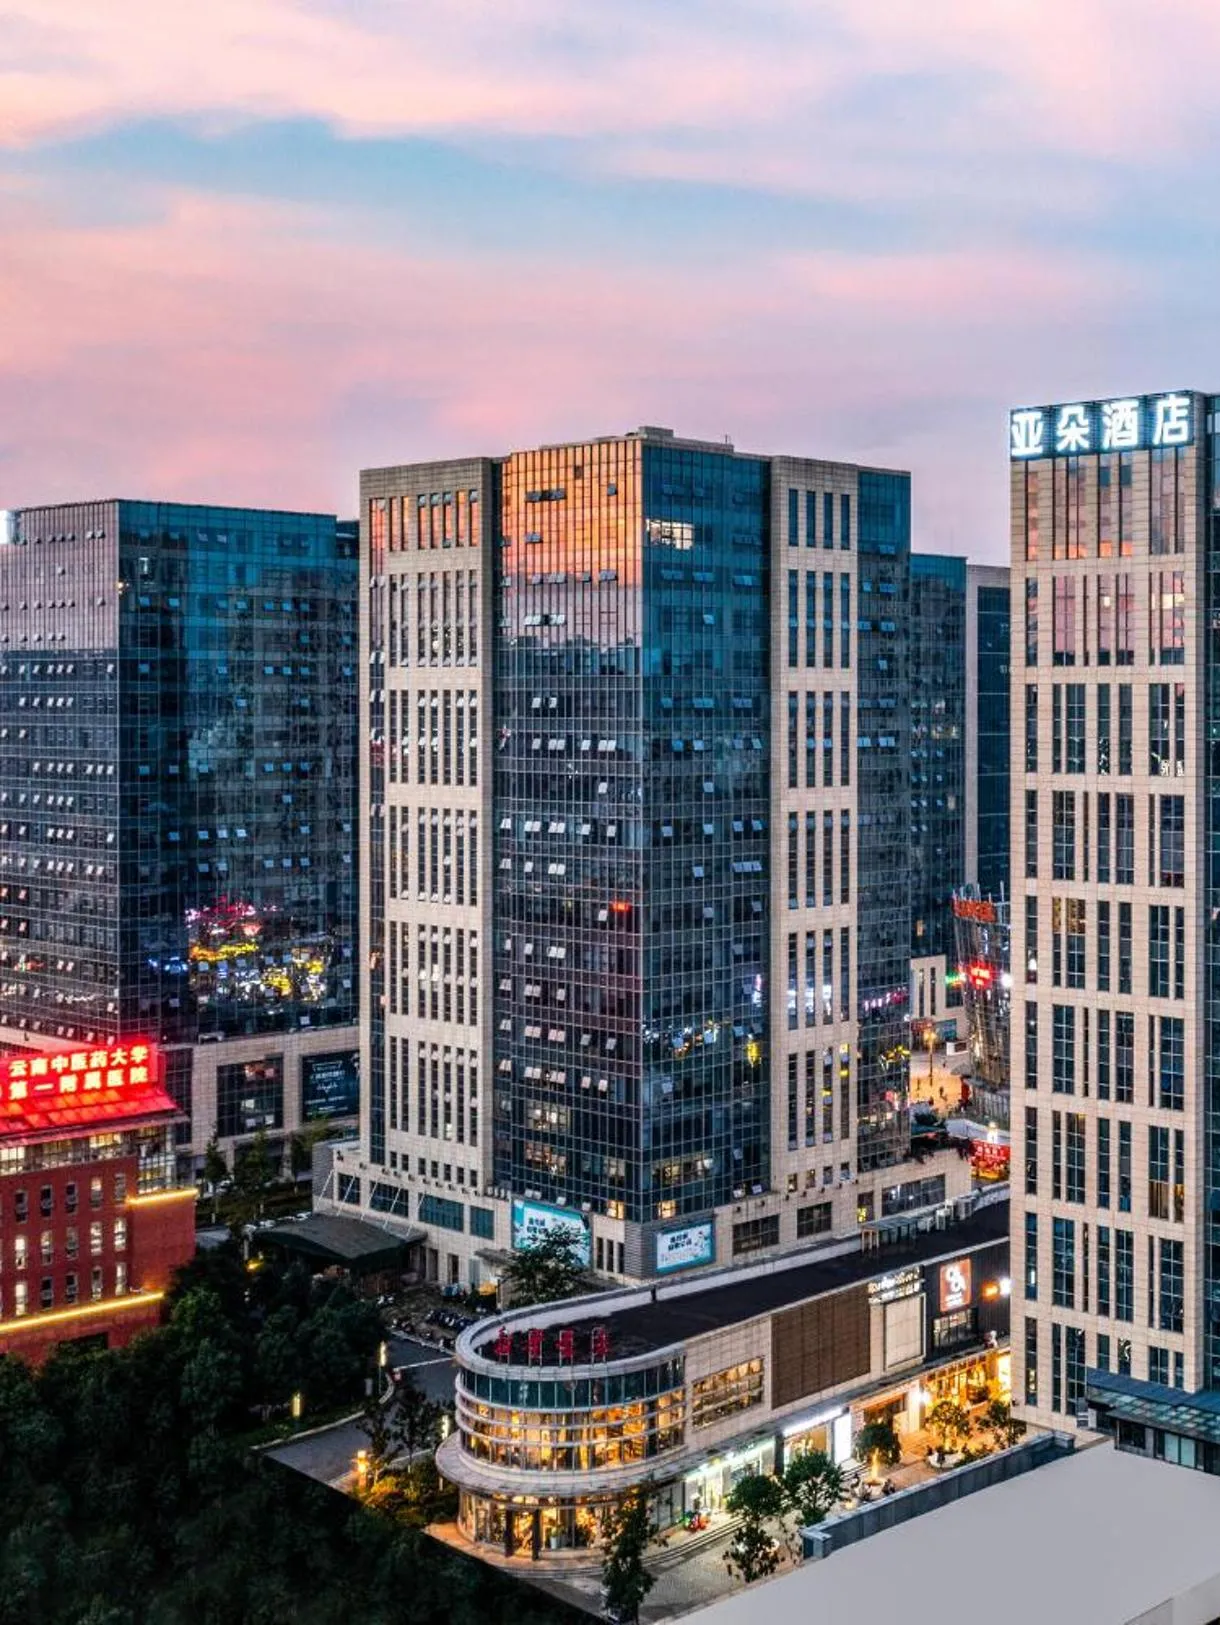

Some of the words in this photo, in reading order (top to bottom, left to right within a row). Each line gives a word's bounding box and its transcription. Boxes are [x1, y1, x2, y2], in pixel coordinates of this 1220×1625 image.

[1011, 394, 1190, 456] 亚朵酒店
[8, 1045, 148, 1077] 云南中医药大学
